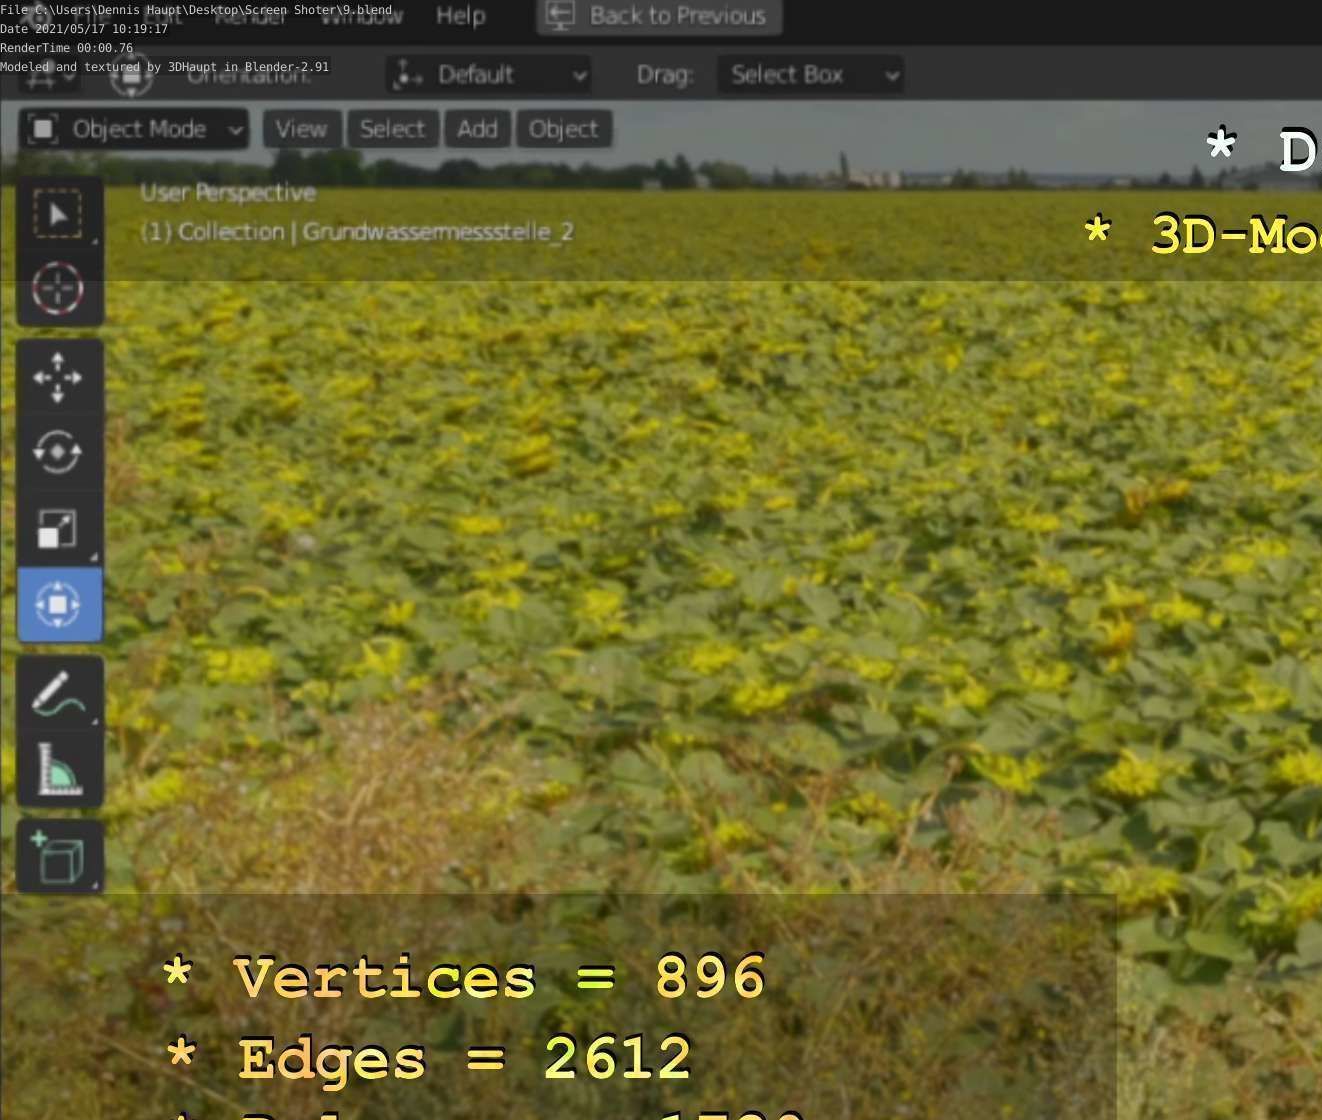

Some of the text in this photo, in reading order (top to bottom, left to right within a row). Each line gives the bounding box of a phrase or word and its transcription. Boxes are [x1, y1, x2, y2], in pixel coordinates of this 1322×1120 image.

[437, 6, 486, 29] Help
[590, 5, 767, 25] Back to Previous
[439, 64, 515, 84] Default
[637, 64, 694, 90] Drag:
[731, 64, 843, 84] Select Box
[74, 118, 207, 142] Object Mode
[275, 118, 327, 139] View
[360, 118, 425, 139] Select
[456, 118, 498, 138] Add
[528, 118, 599, 142] Object
[141, 183, 317, 208] User Perspective
[141, 221, 172, 244] (1)
[179, 221, 285, 243] Collection
[303, 221, 573, 245] Grundwassermessstelle_2
